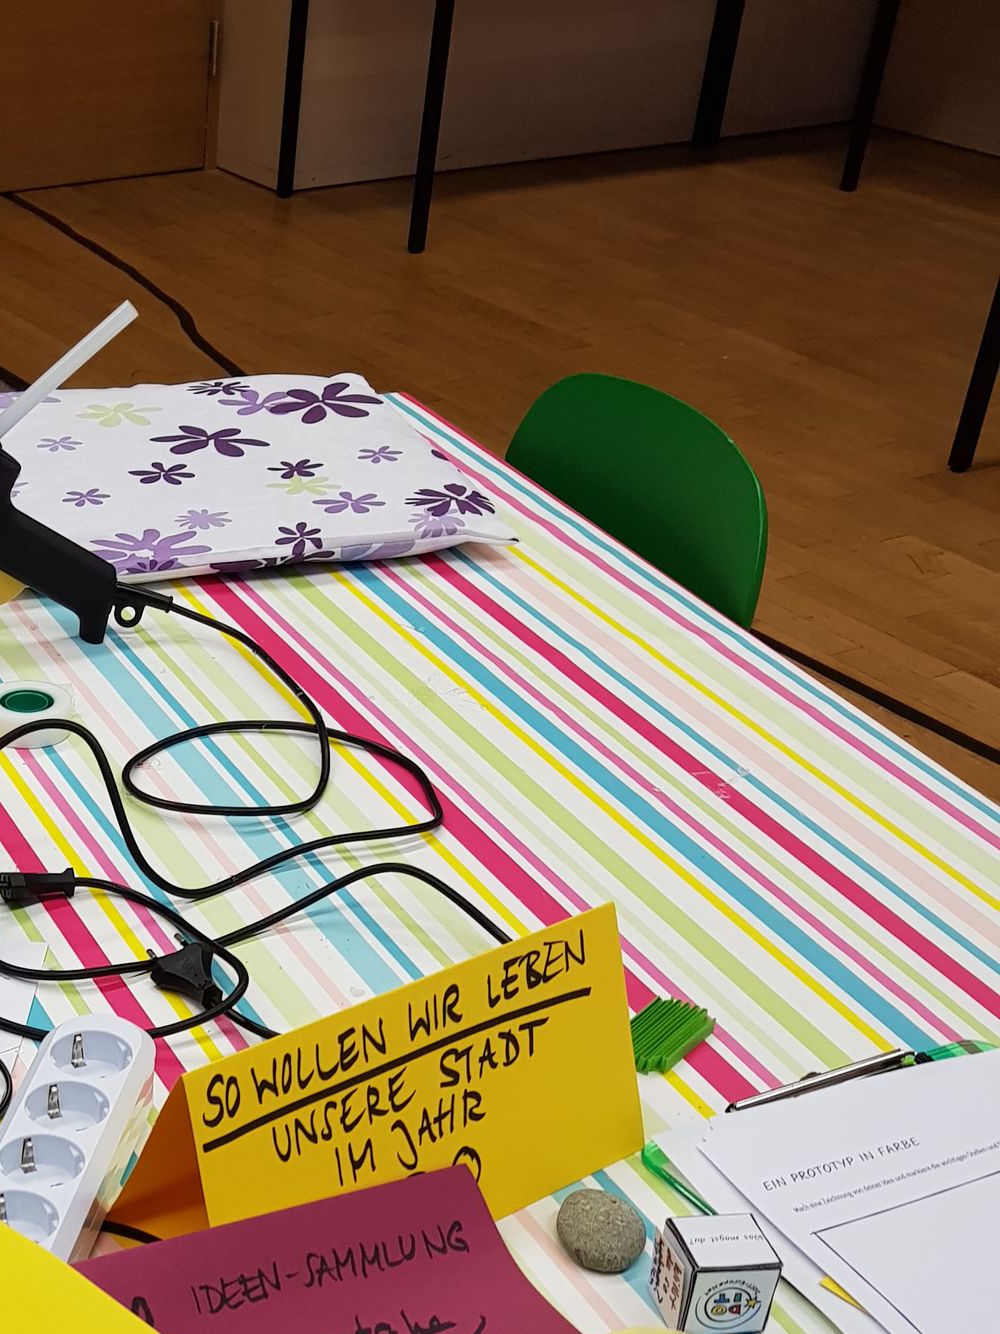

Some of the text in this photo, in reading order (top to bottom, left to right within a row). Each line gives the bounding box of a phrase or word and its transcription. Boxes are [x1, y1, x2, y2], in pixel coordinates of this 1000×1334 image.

[202, 929, 587, 1128] SO WOLLEN WIR LEBEN
[271, 1017, 550, 1163] UNSERE STADT
[334, 1138, 376, 1187] IM
[390, 1089, 487, 1170] JAHR
[762, 1136, 921, 1192] EIN PROTOTYP IN FARBE
[190, 1219, 471, 1316] IDEEN-SAMMLUNG
[710, 1234, 740, 1244] magst
